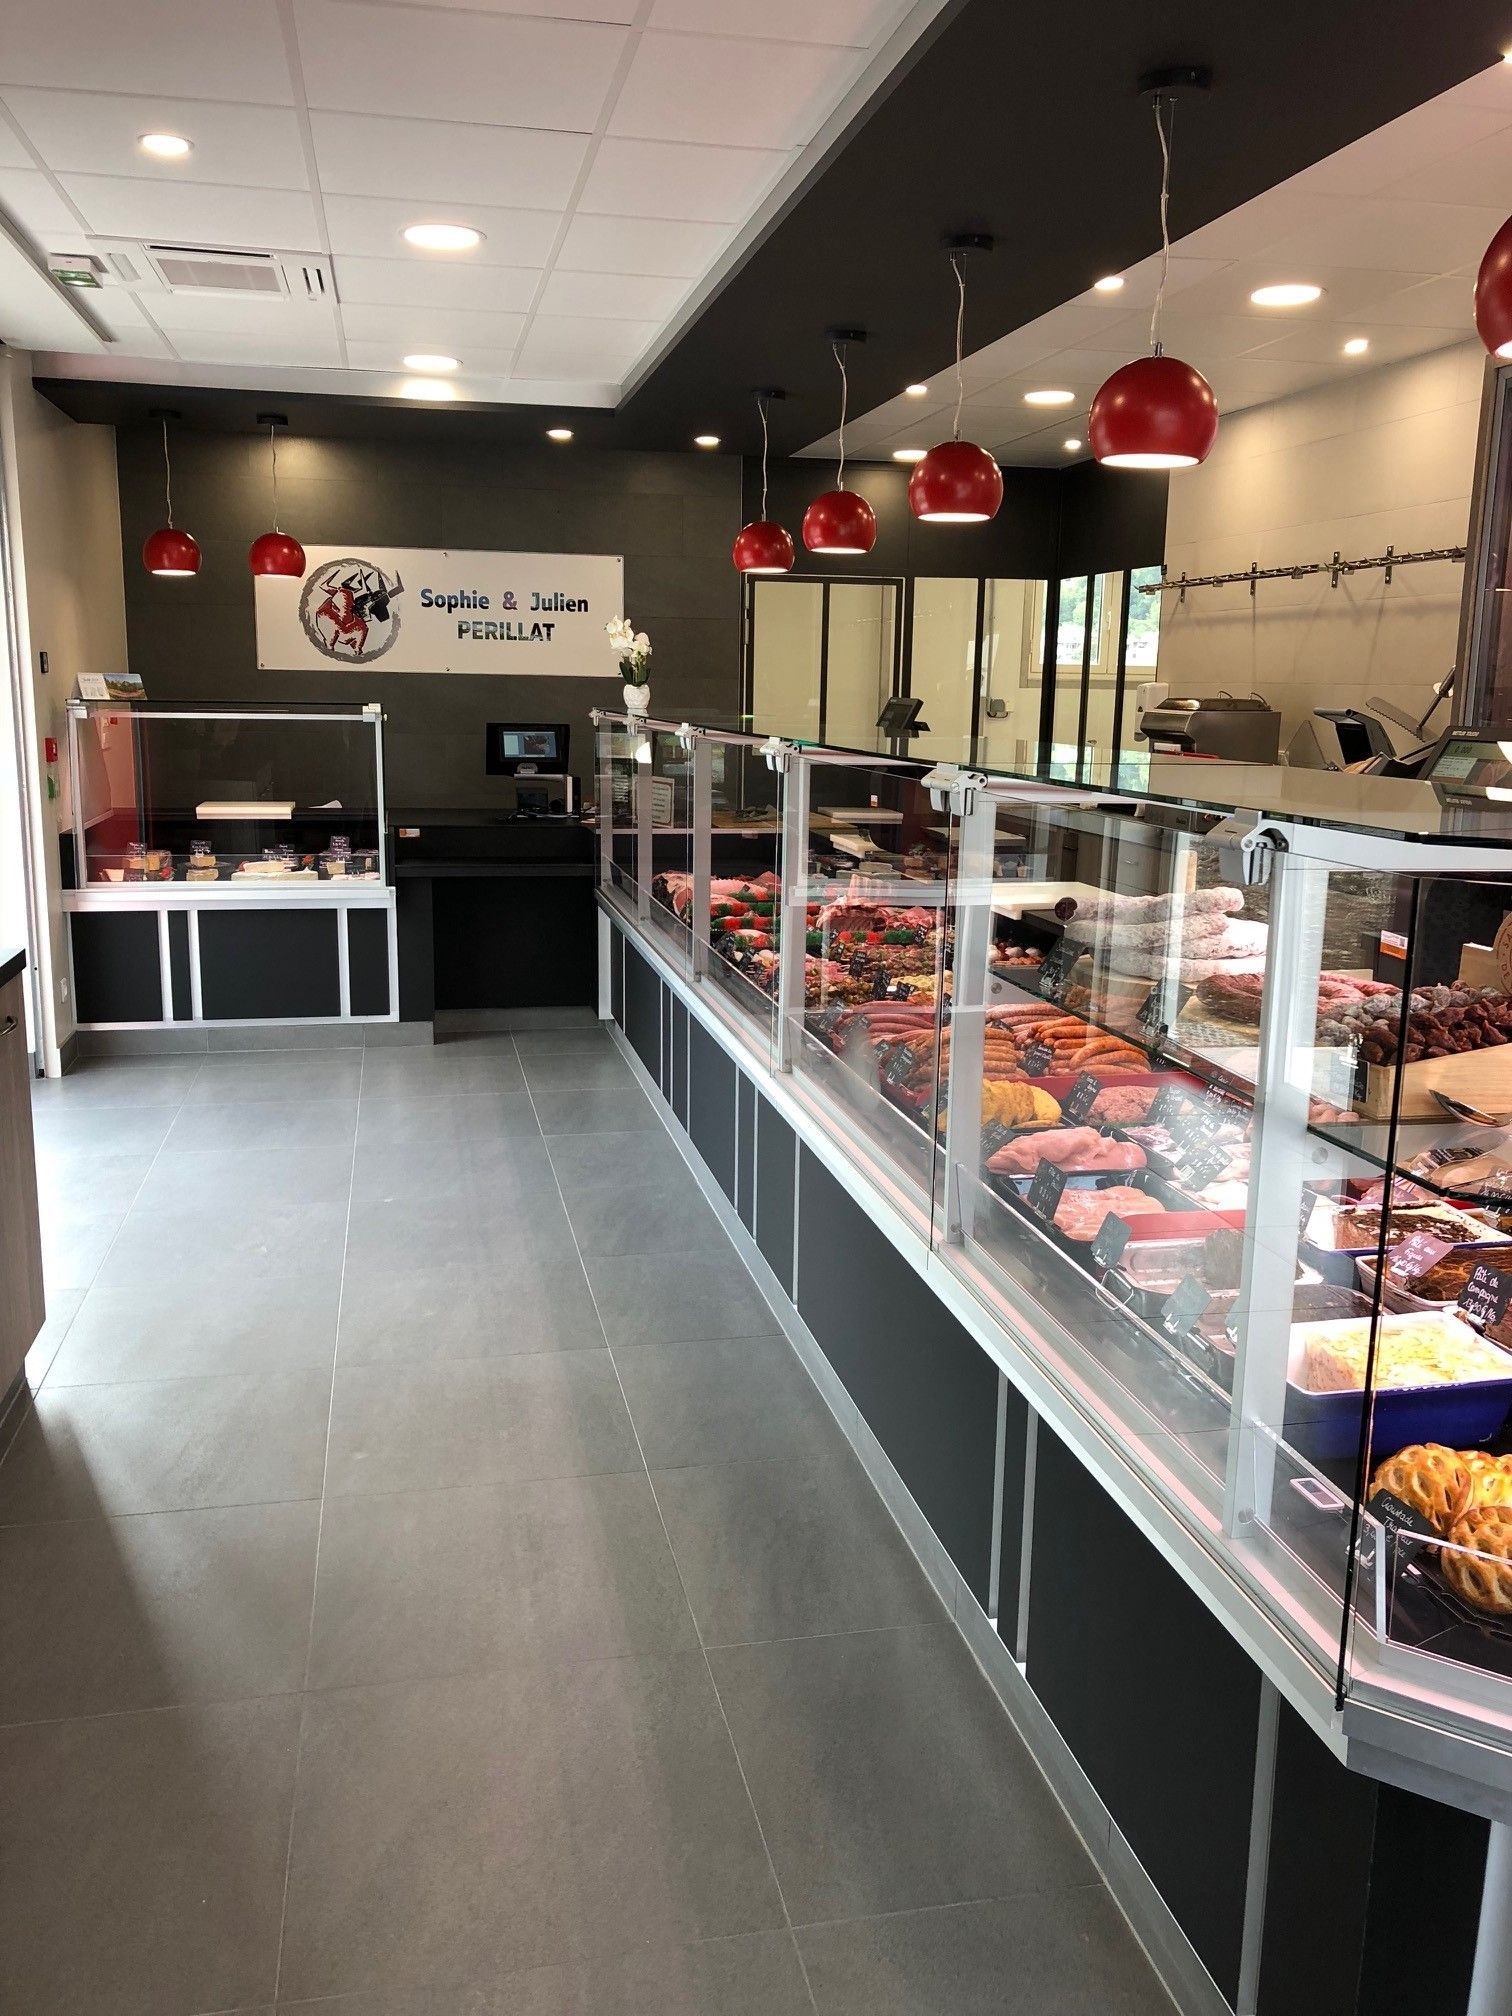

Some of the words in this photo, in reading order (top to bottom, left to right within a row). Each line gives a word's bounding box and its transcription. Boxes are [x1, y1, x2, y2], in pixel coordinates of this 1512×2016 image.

[420, 588, 490, 614] Sophie
[502, 590, 518, 611] &
[530, 592, 589, 612] Julien
[457, 620, 555, 642] PERILLAT
